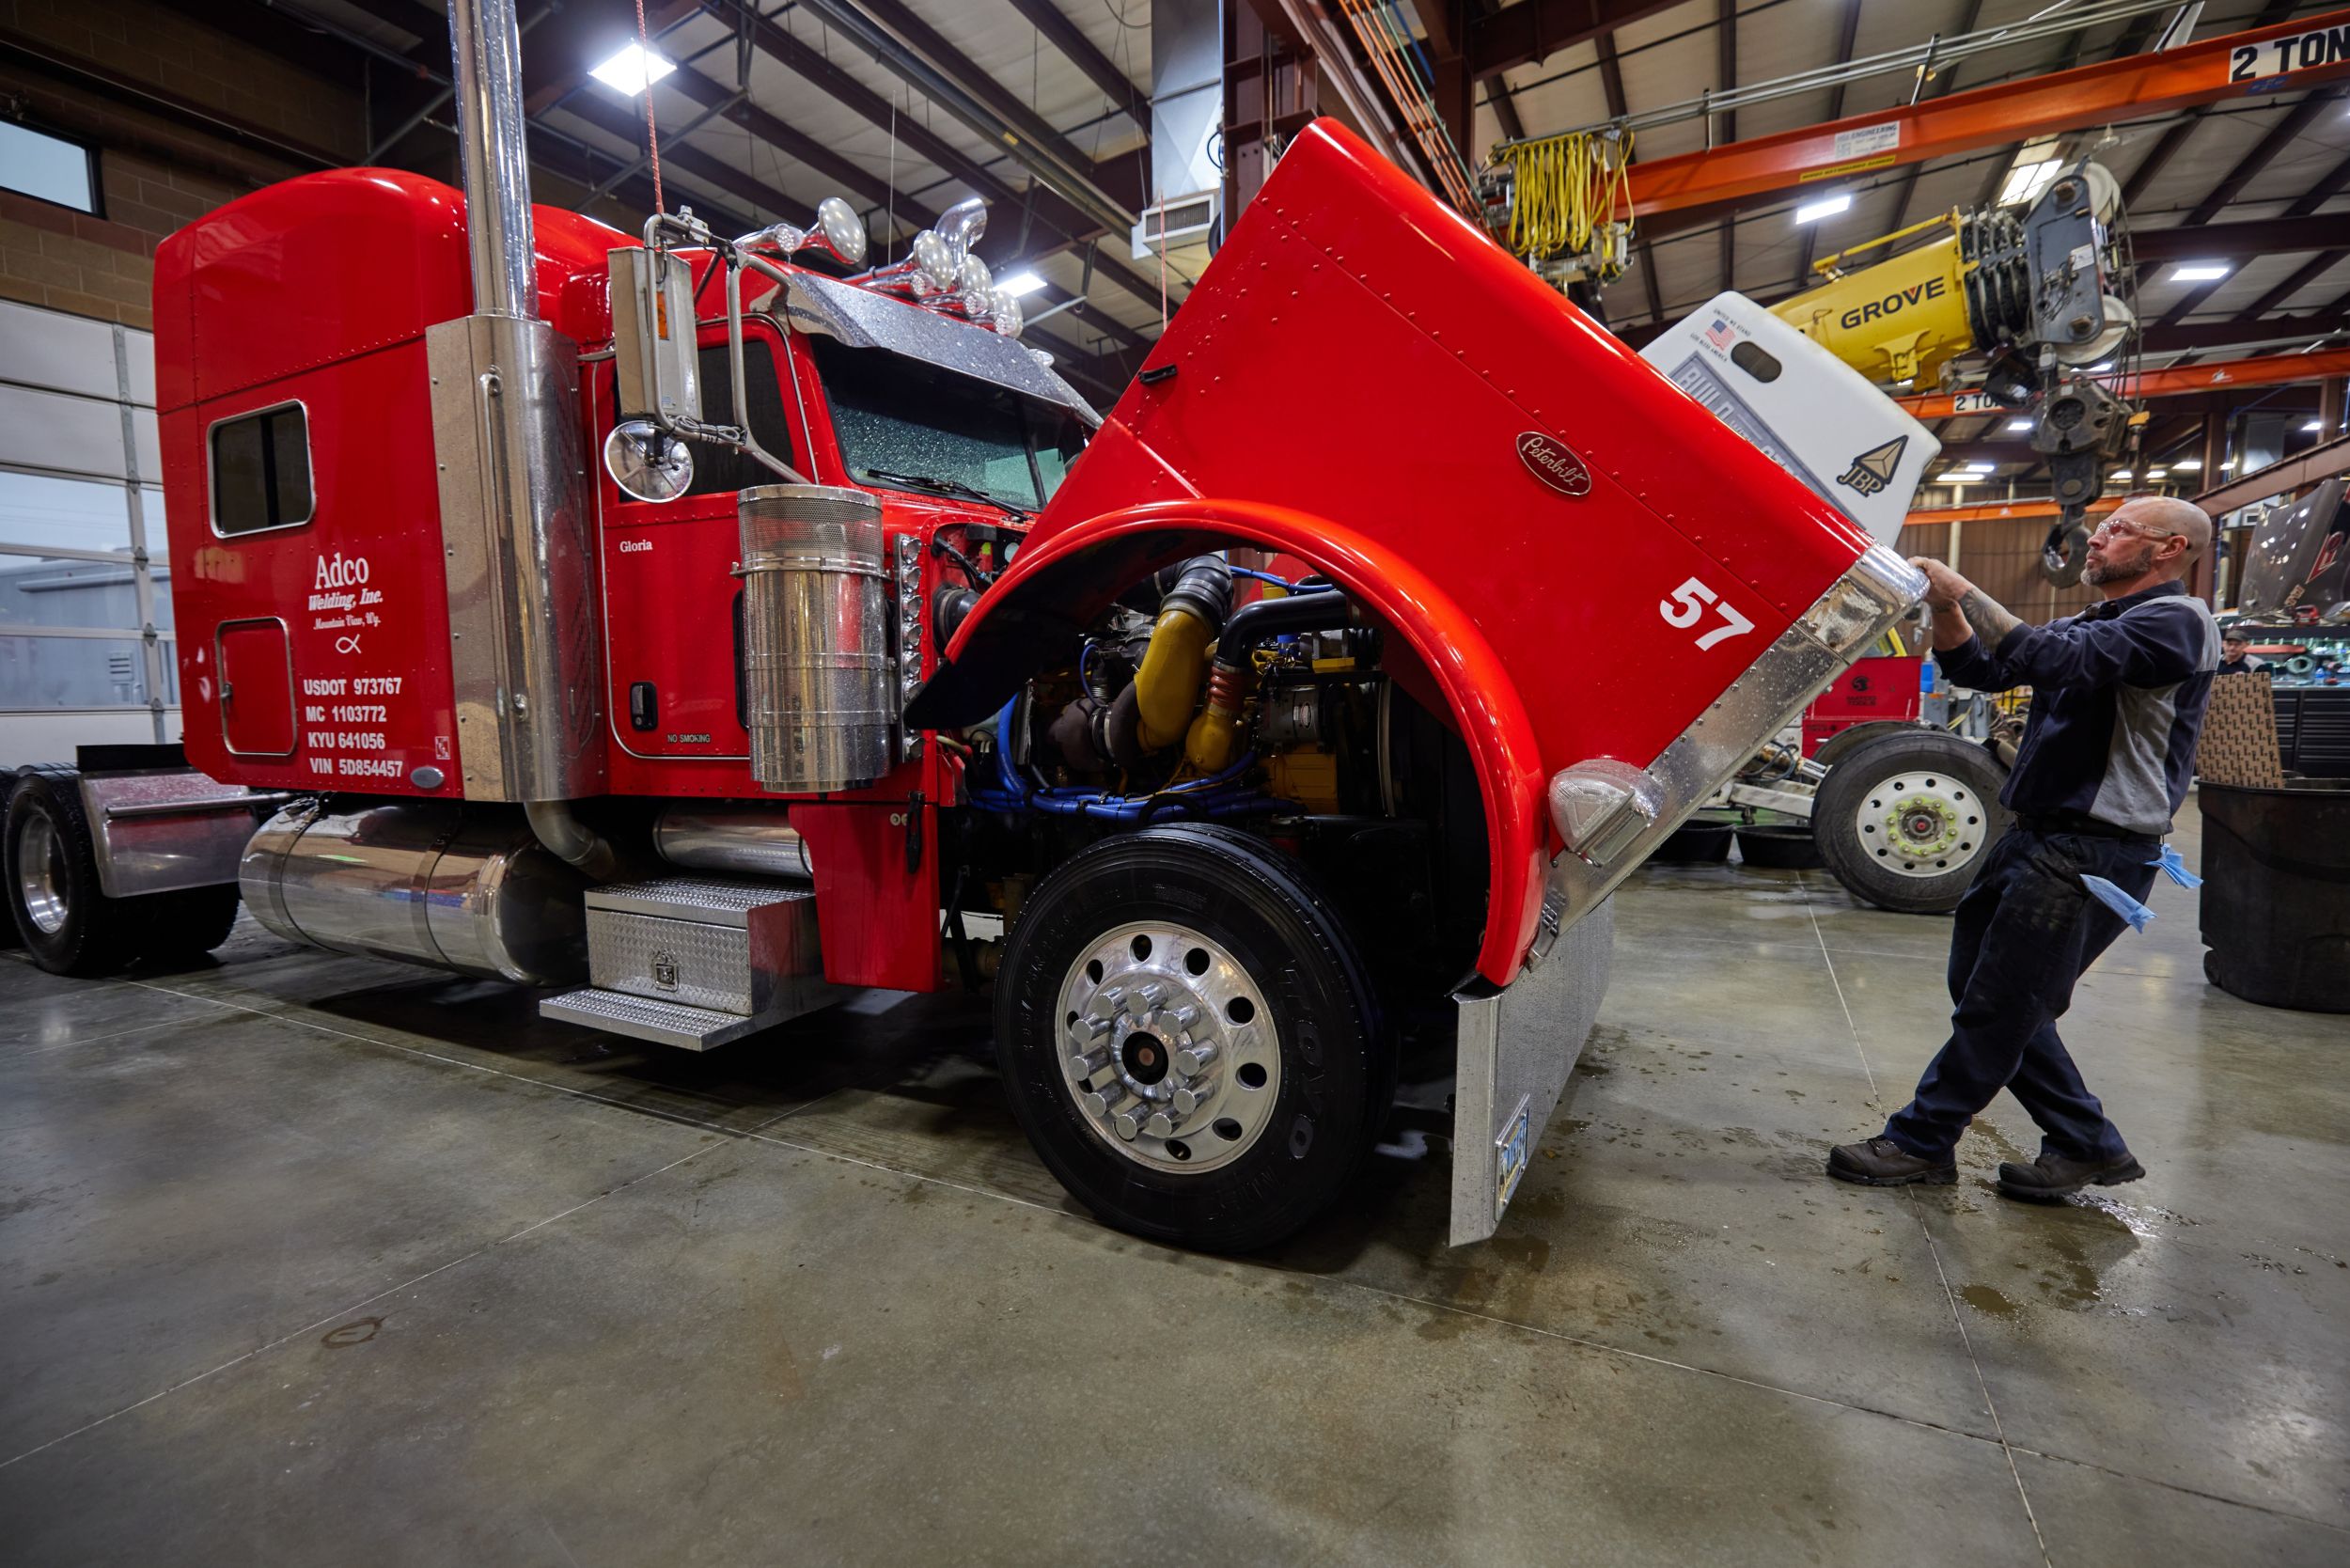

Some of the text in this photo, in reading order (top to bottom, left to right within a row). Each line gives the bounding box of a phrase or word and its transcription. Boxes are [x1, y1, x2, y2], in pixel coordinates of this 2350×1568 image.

[2232, 25, 2350, 83] 2 TON
[1841, 276, 1946, 330] GROVE
[1955, 394, 2000, 411] 2 TO
[1522, 436, 1588, 487] Peterbilt
[1836, 464, 1885, 497] JBP
[619, 539, 653, 553] Gloria
[315, 552, 369, 589] Adco
[308, 588, 384, 611] Welding, Inc.
[1659, 576, 1756, 651] 57
[304, 677, 402, 696] USDOT 973767
[306, 705, 387, 722] MC 1103772
[307, 731, 385, 749] KYU 641056
[667, 734, 711, 743] NO SMOKING
[309, 758, 403, 777] VIN 5D854457
